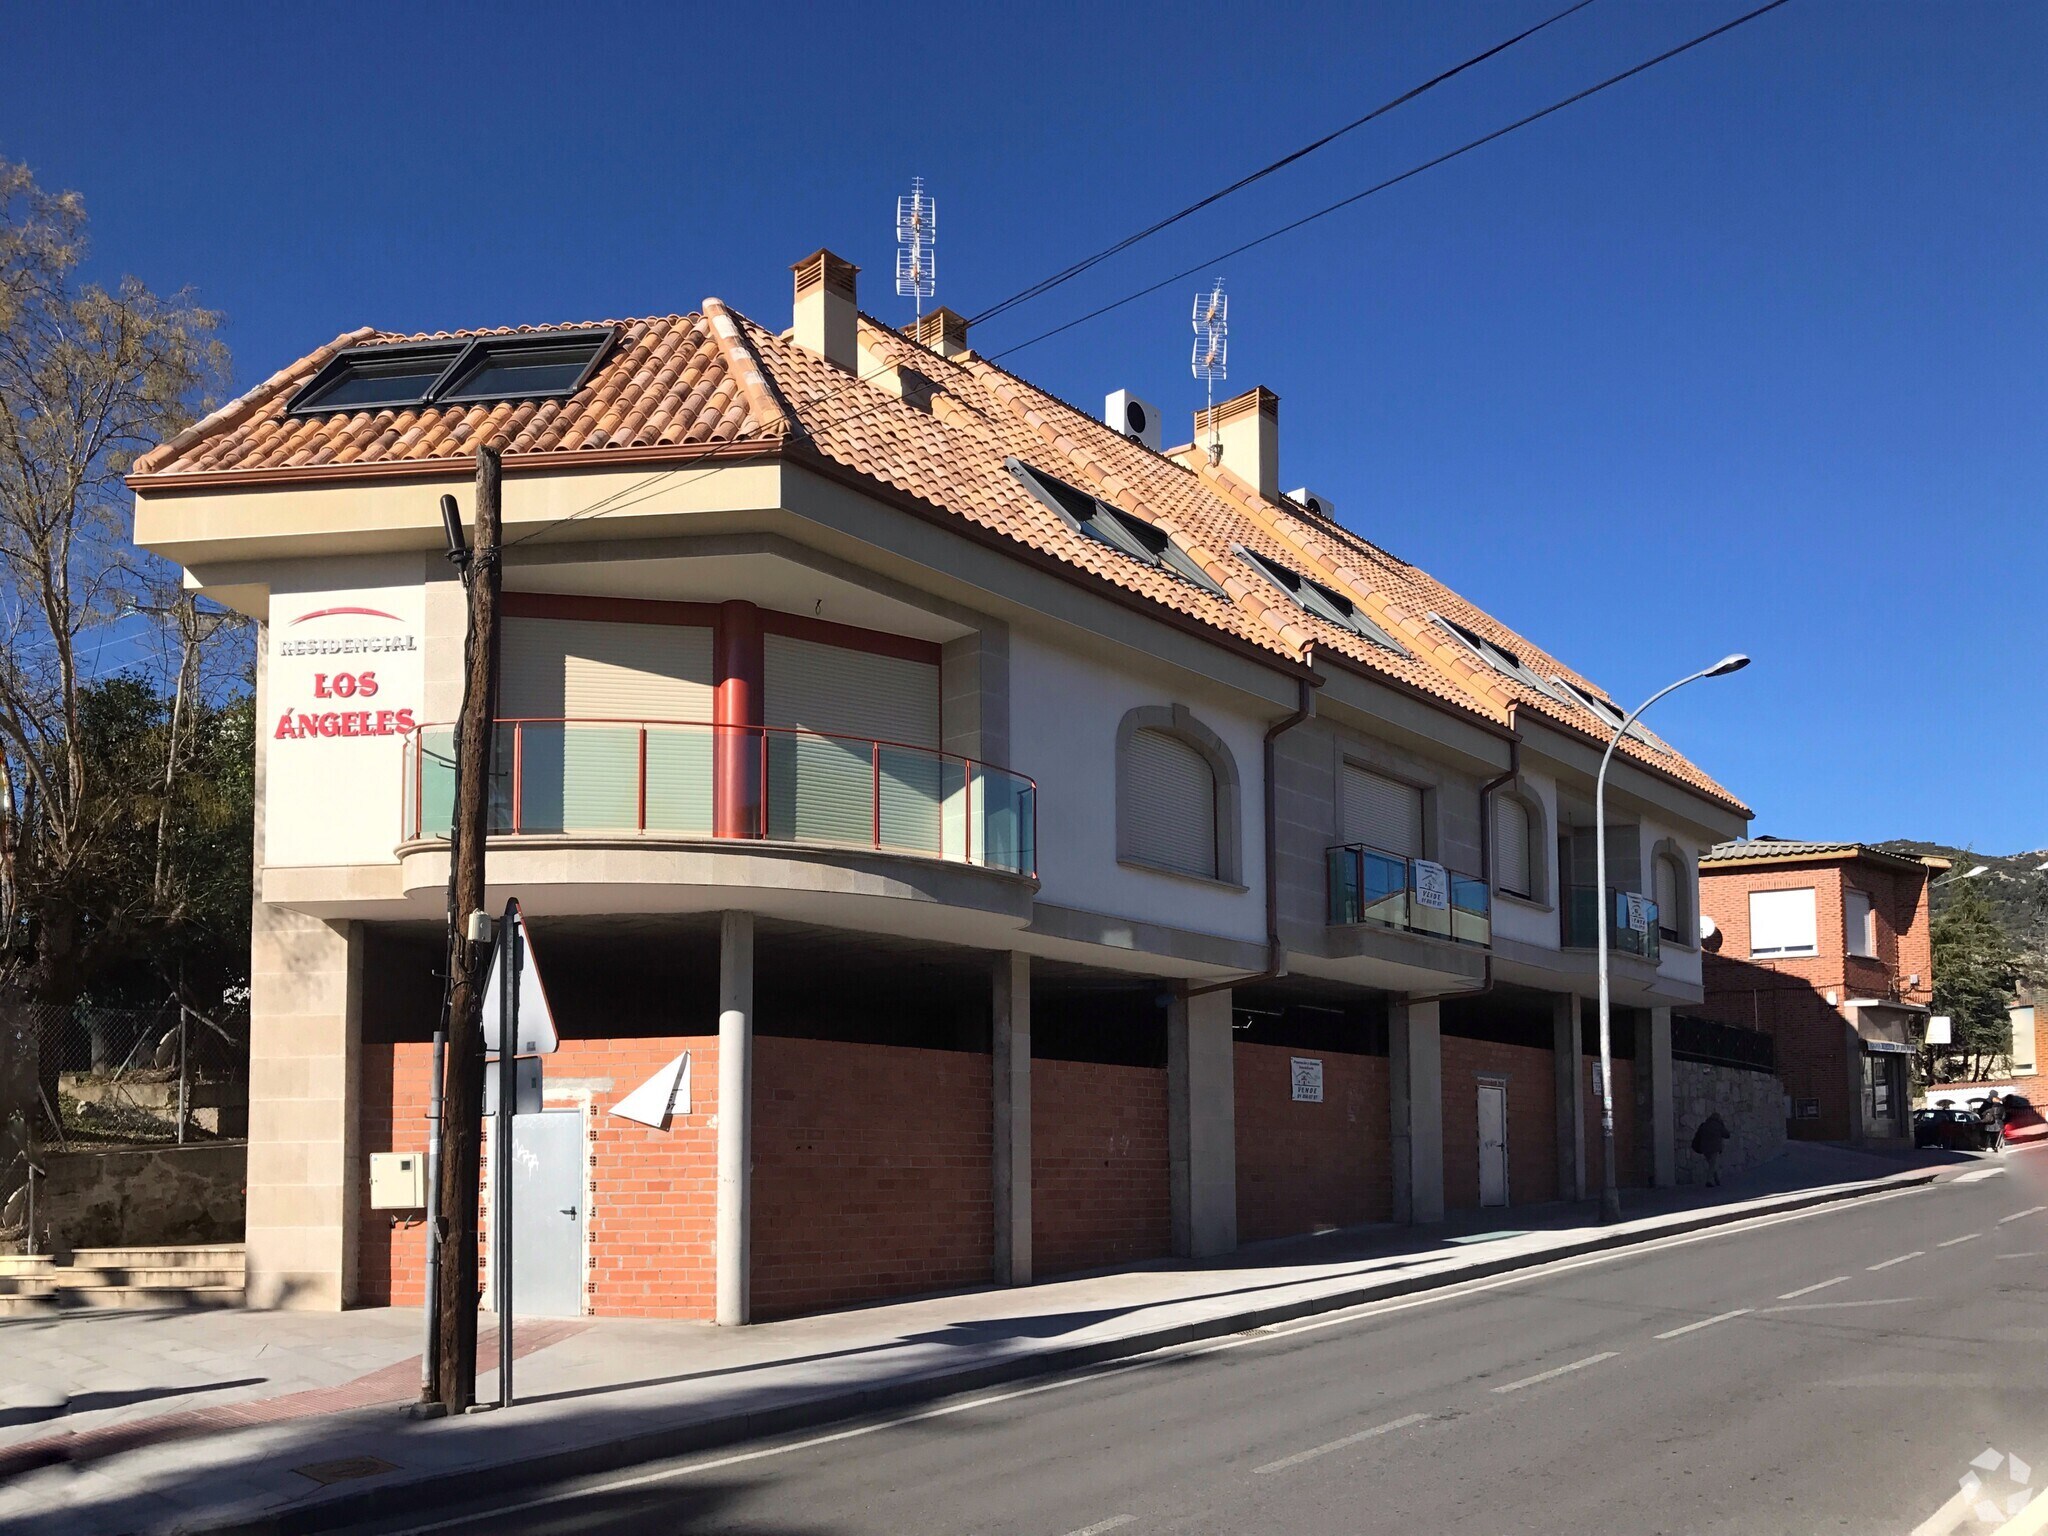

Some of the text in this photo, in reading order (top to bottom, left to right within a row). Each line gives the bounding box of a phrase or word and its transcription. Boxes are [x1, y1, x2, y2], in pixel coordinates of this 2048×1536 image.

[279, 635, 417, 656] RESIDENCIAL
[314, 671, 378, 698] LOS
[274, 707, 416, 739] ÁNGELES
[1297, 1086, 1317, 1094] VENDE
